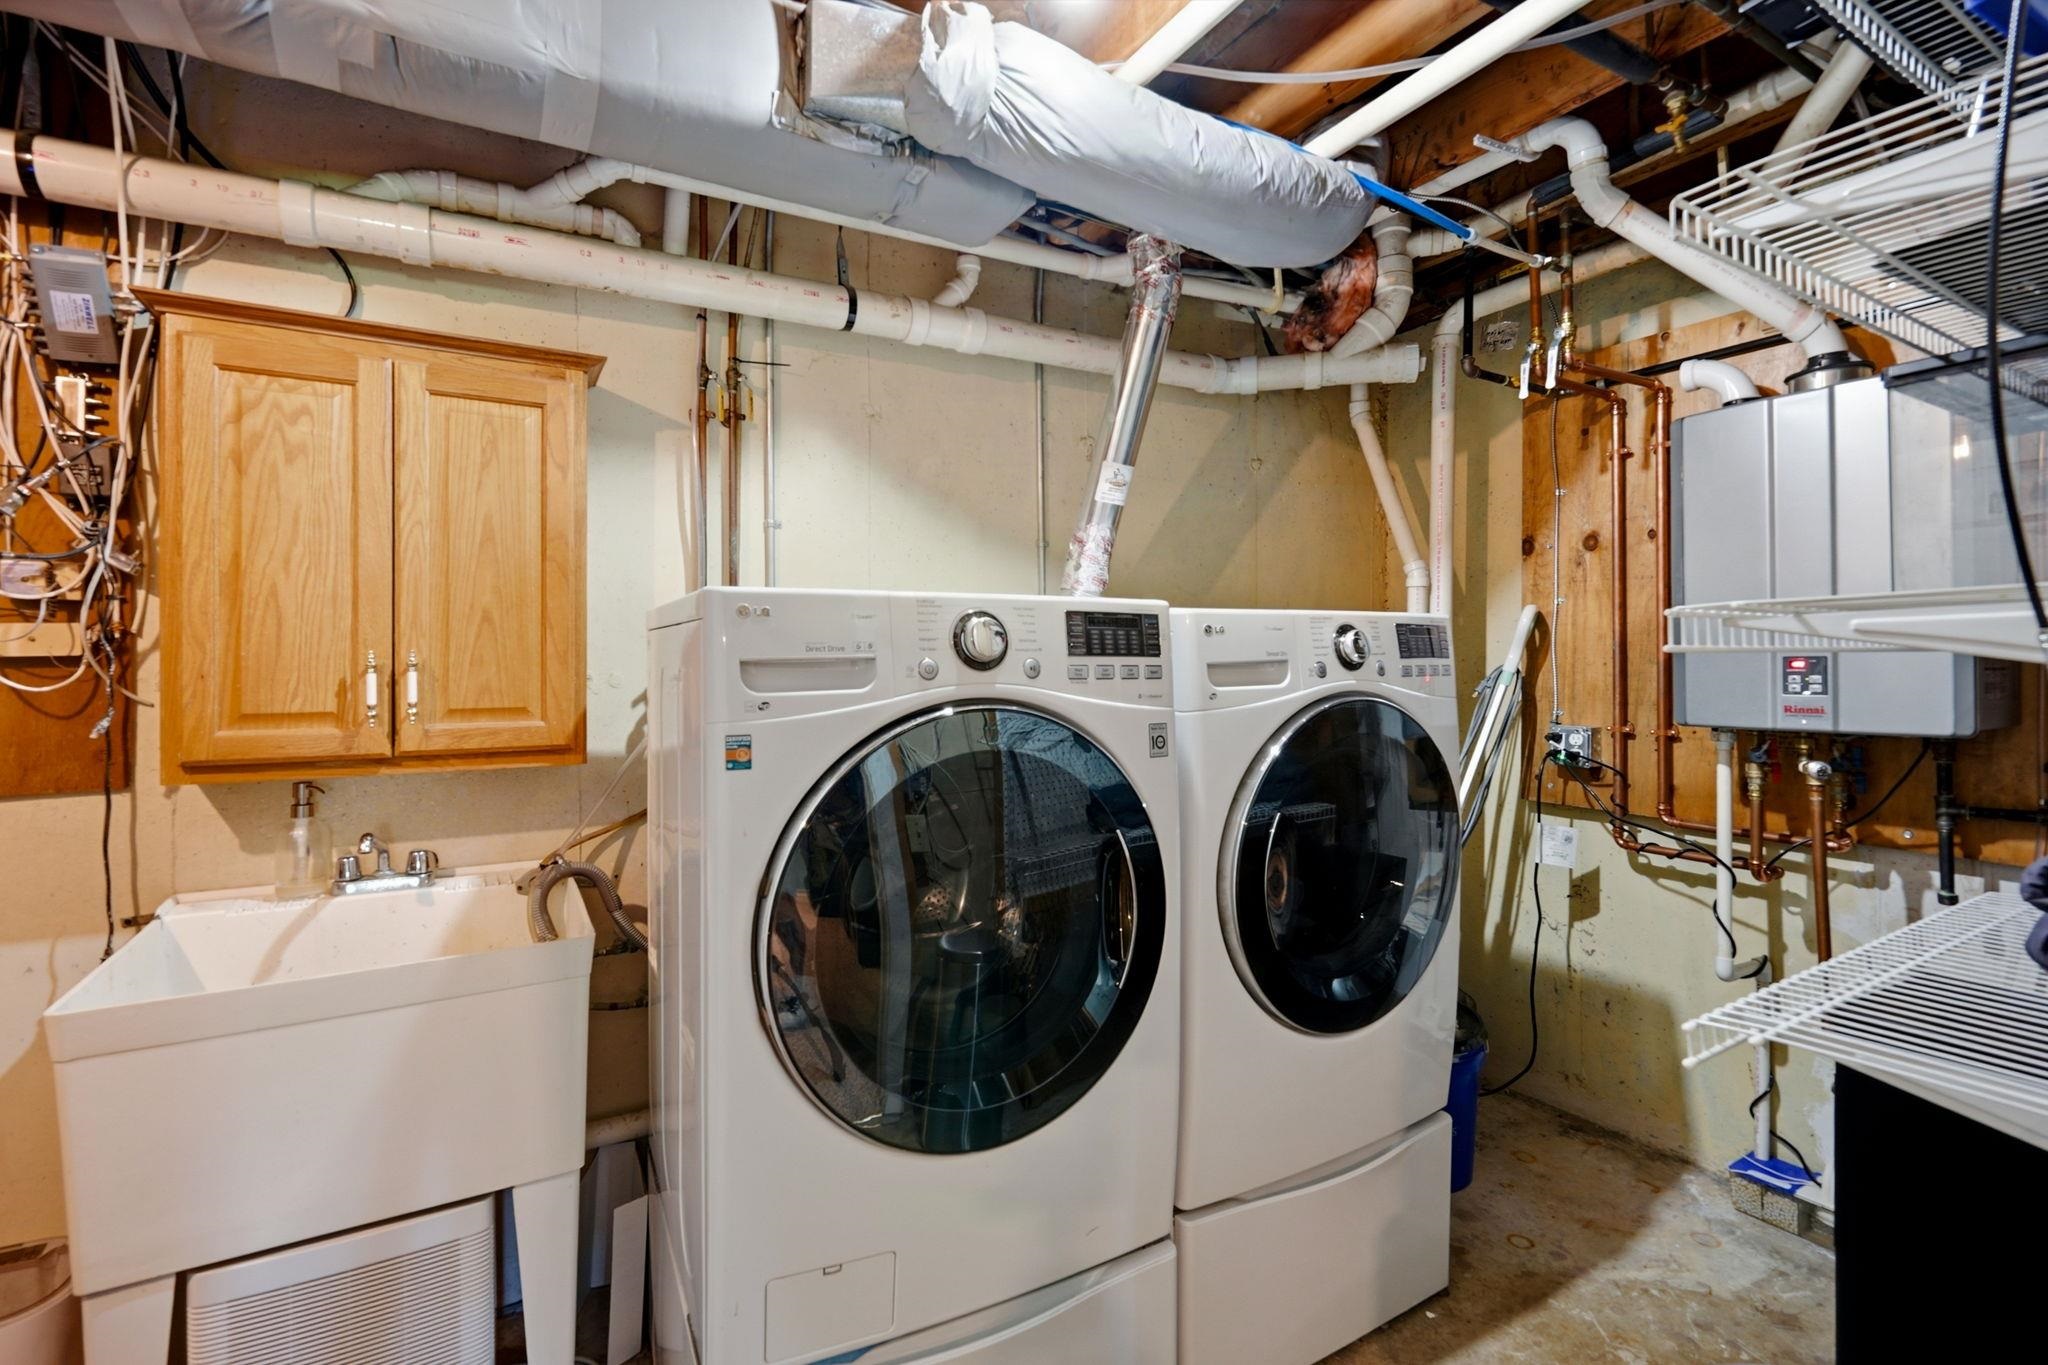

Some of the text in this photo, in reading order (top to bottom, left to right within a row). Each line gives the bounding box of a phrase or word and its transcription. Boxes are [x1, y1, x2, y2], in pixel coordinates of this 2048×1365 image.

[753, 606, 770, 617] LG
[1214, 626, 1225, 634] LG
[1783, 704, 1826, 715] Rinnai
